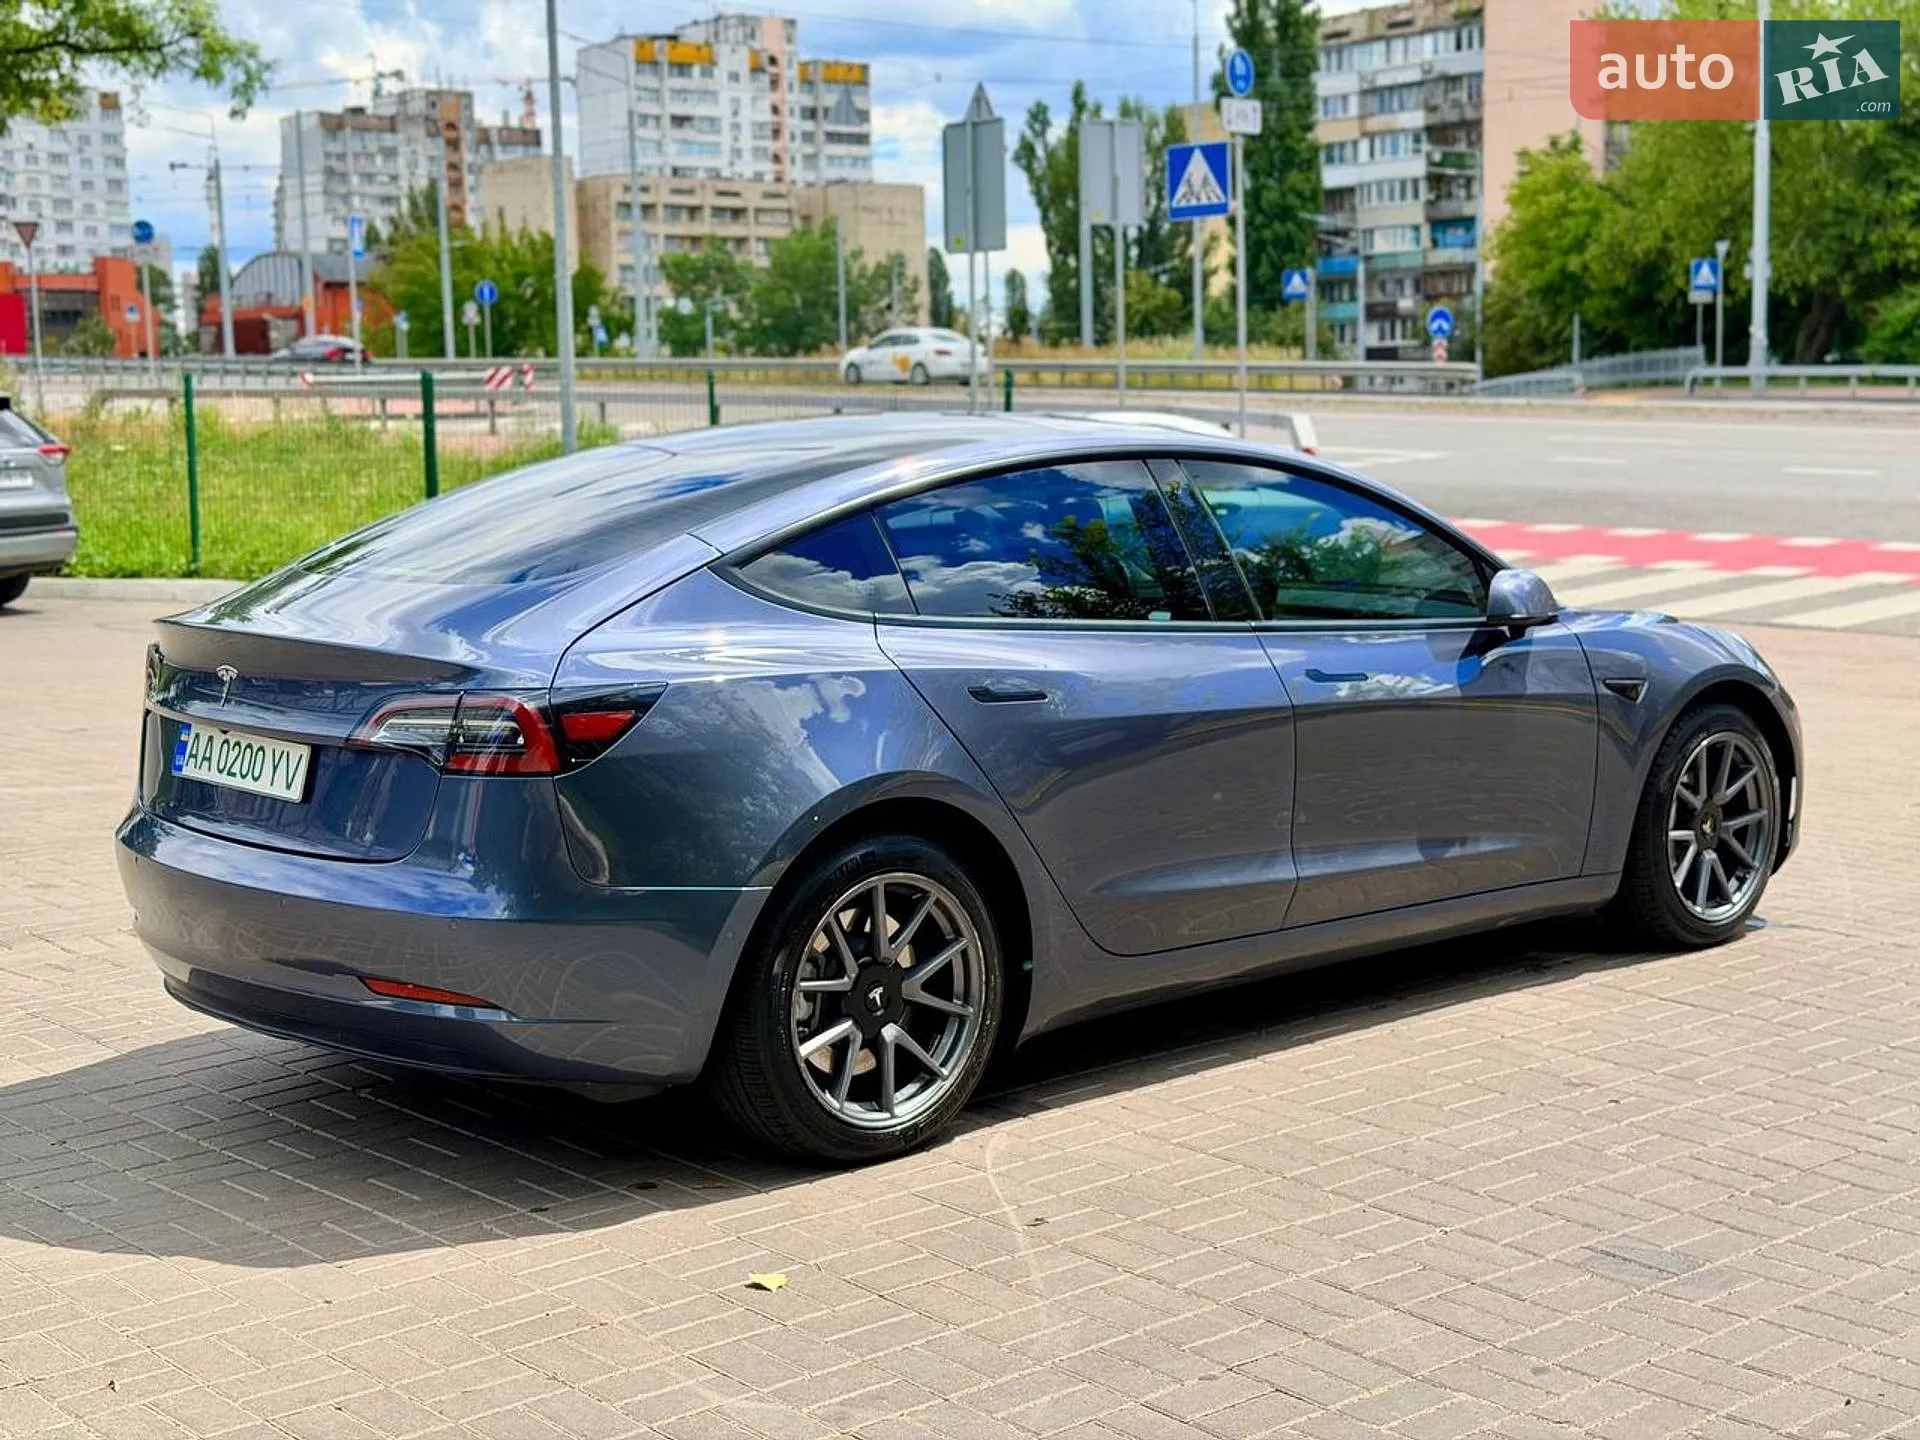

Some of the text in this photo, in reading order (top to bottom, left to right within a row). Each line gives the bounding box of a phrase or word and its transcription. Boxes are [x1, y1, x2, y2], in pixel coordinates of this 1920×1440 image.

[185, 732, 303, 790] AA 0200 YV
